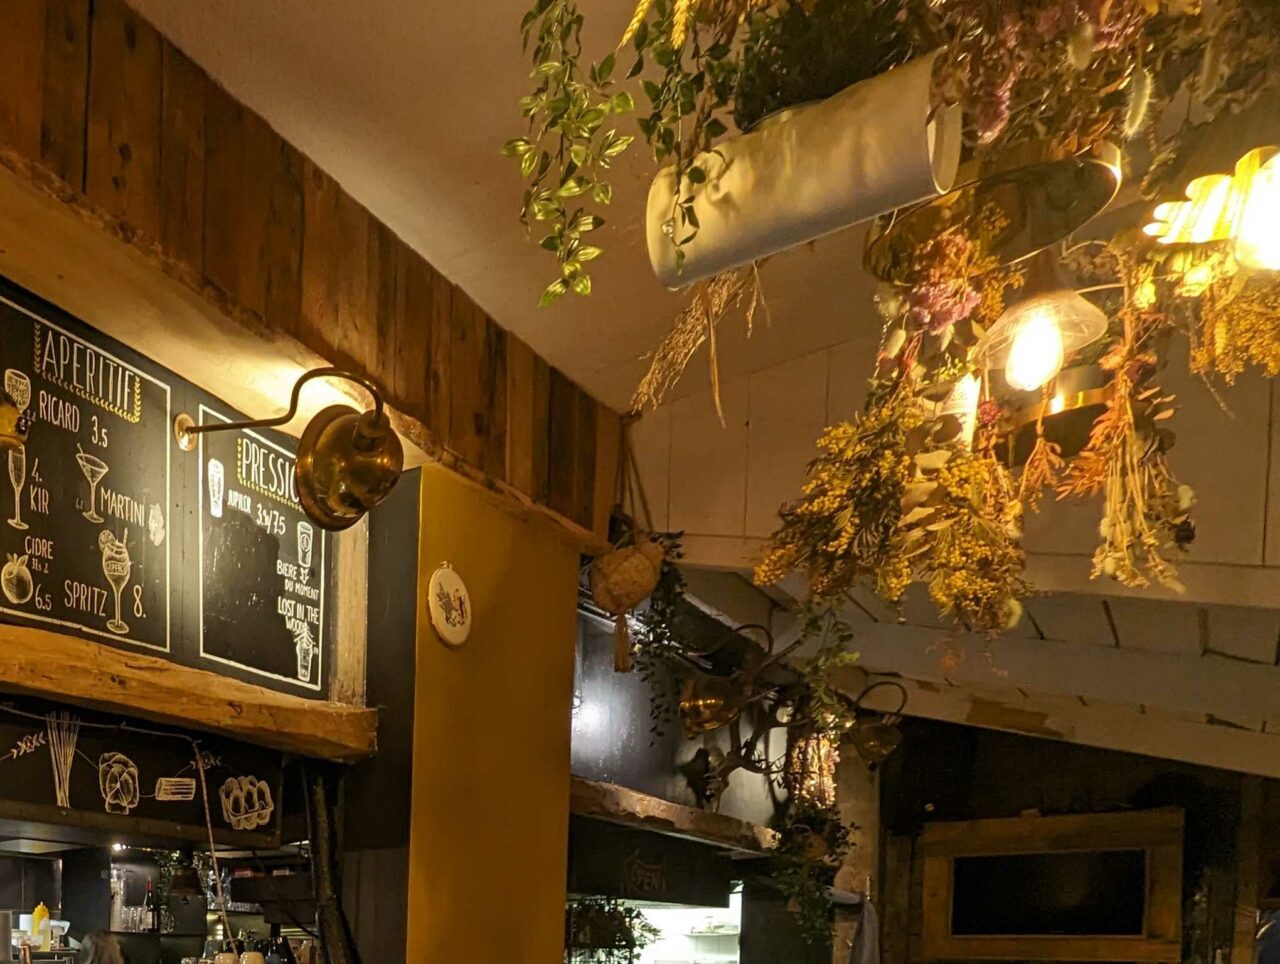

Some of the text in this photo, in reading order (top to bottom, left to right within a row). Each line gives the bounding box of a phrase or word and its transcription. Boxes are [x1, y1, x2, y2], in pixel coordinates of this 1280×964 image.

[41, 330, 134, 413] APERITIF
[38, 390, 81, 434] RICARD
[29, 485, 50, 516] KIR
[100, 487, 145, 528] MARTINI
[24, 535, 55, 560] CIDRE
[276, 559, 298, 581] BIERE
[63, 580, 108, 618] SPRITZ
[294, 583, 320, 601] MOMENT
[277, 595, 320, 625] LOST IN THE
